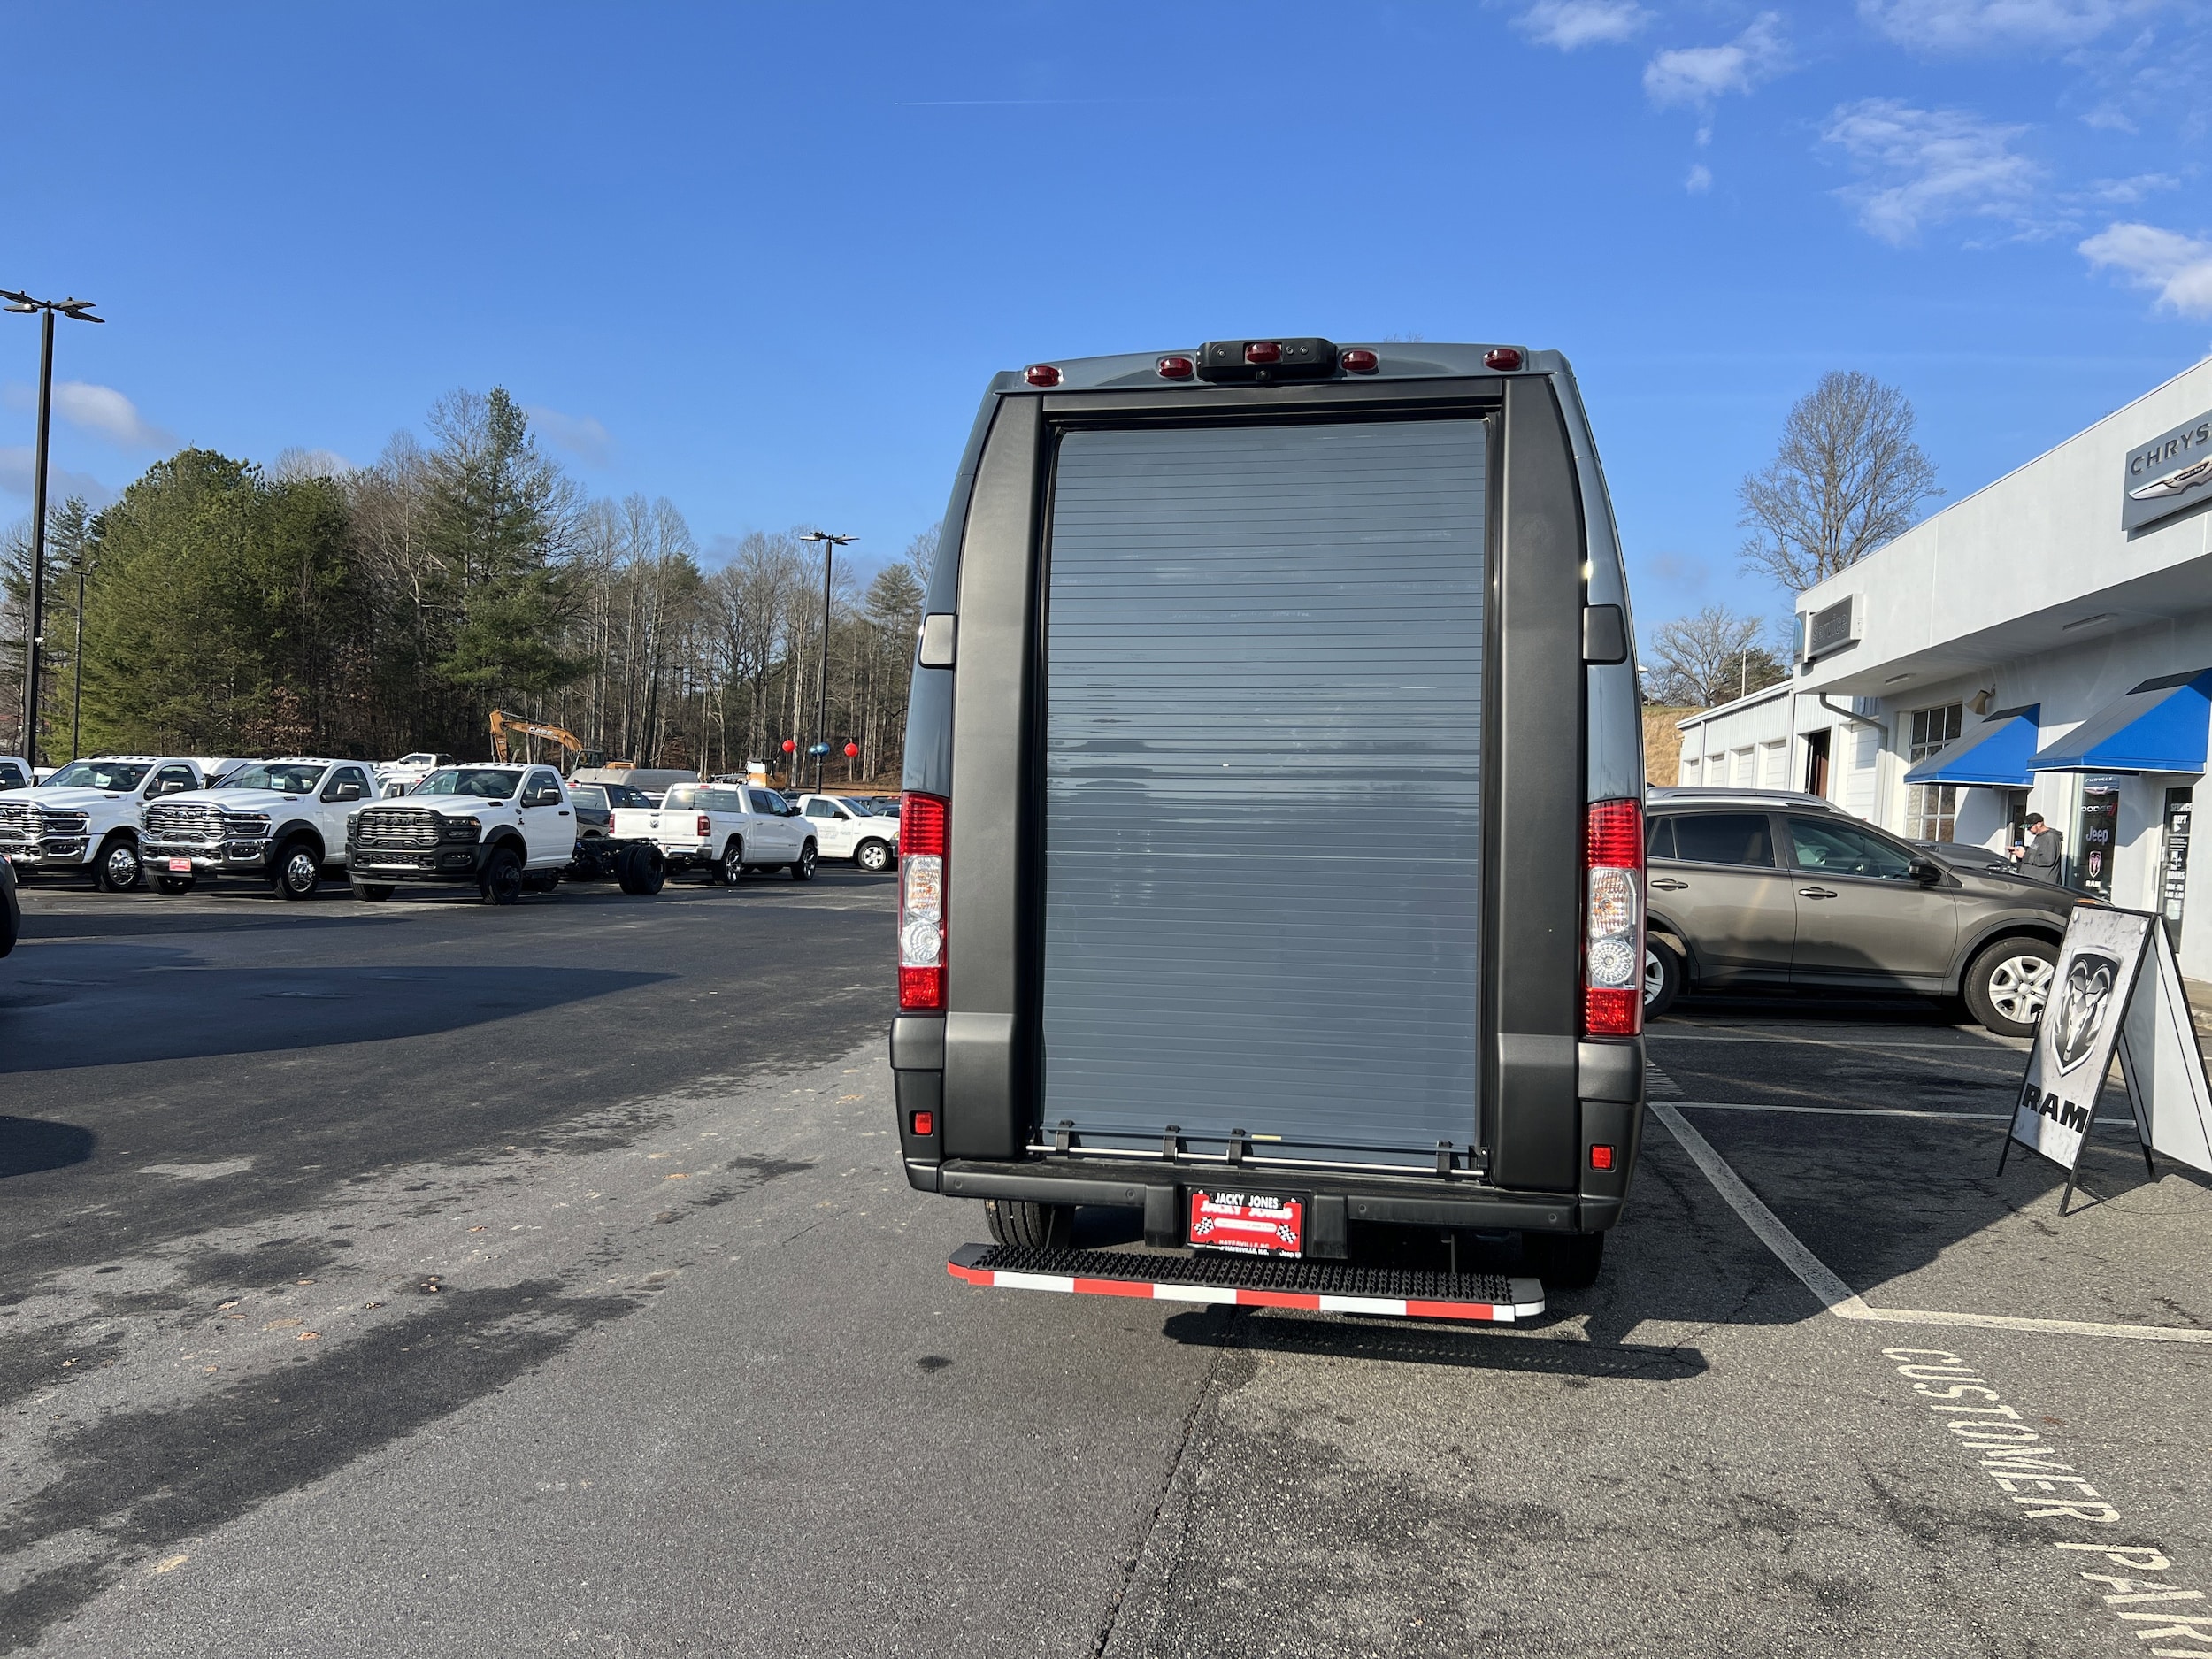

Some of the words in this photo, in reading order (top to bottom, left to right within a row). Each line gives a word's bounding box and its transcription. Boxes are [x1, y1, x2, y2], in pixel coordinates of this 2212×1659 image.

[1812, 614, 1847, 645] Service
[528, 726, 554, 736] CASE
[2085, 826, 2109, 845] Jeep
[2085, 879, 2101, 888] RAM
[2166, 871, 2185, 880] HOURS
[2021, 1083, 2090, 1134] RAM
[1215, 1192, 1245, 1206] JACKY
[1248, 1195, 1279, 1210] JONES
[1881, 1348, 2121, 1523] CUSTOMER
[2053, 1541, 2212, 1659] PAR
